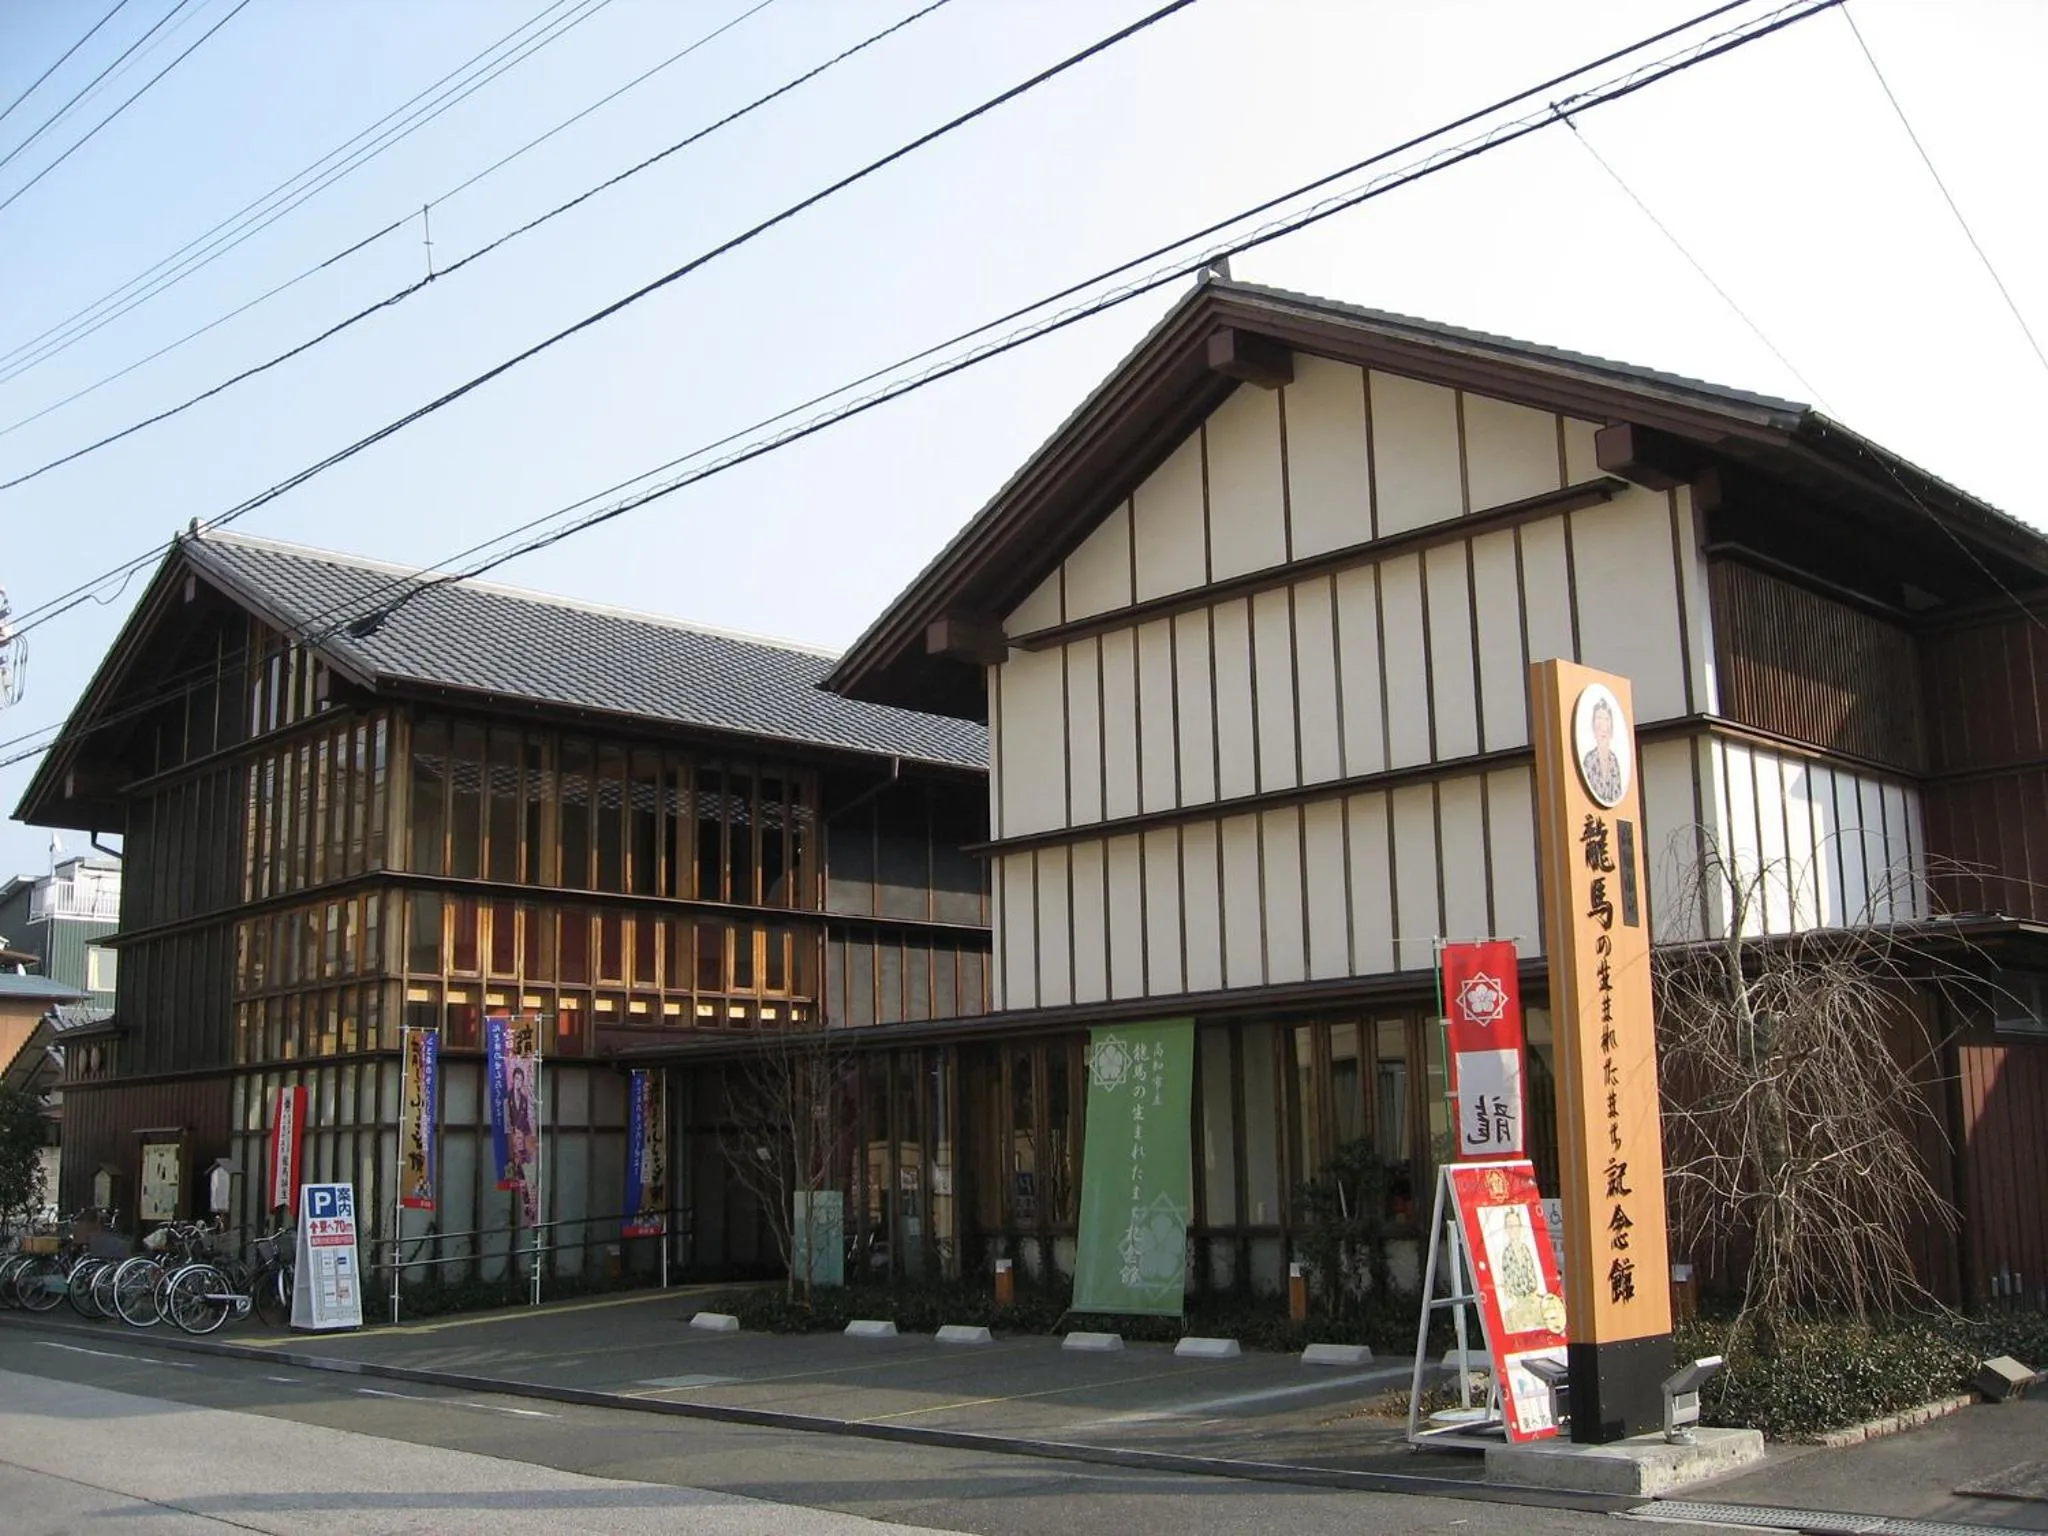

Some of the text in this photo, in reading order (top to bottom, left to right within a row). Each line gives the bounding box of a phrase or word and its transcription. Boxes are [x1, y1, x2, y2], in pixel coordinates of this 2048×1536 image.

[1152, 1041, 1165, 1106] 高知市立
[1579, 812, 1636, 1305] 龍馬の生まれたまち記念館
[315, 1187, 352, 1217] P 案内
[1119, 1041, 1151, 1286] 龍馬の生まれたまち記念館
